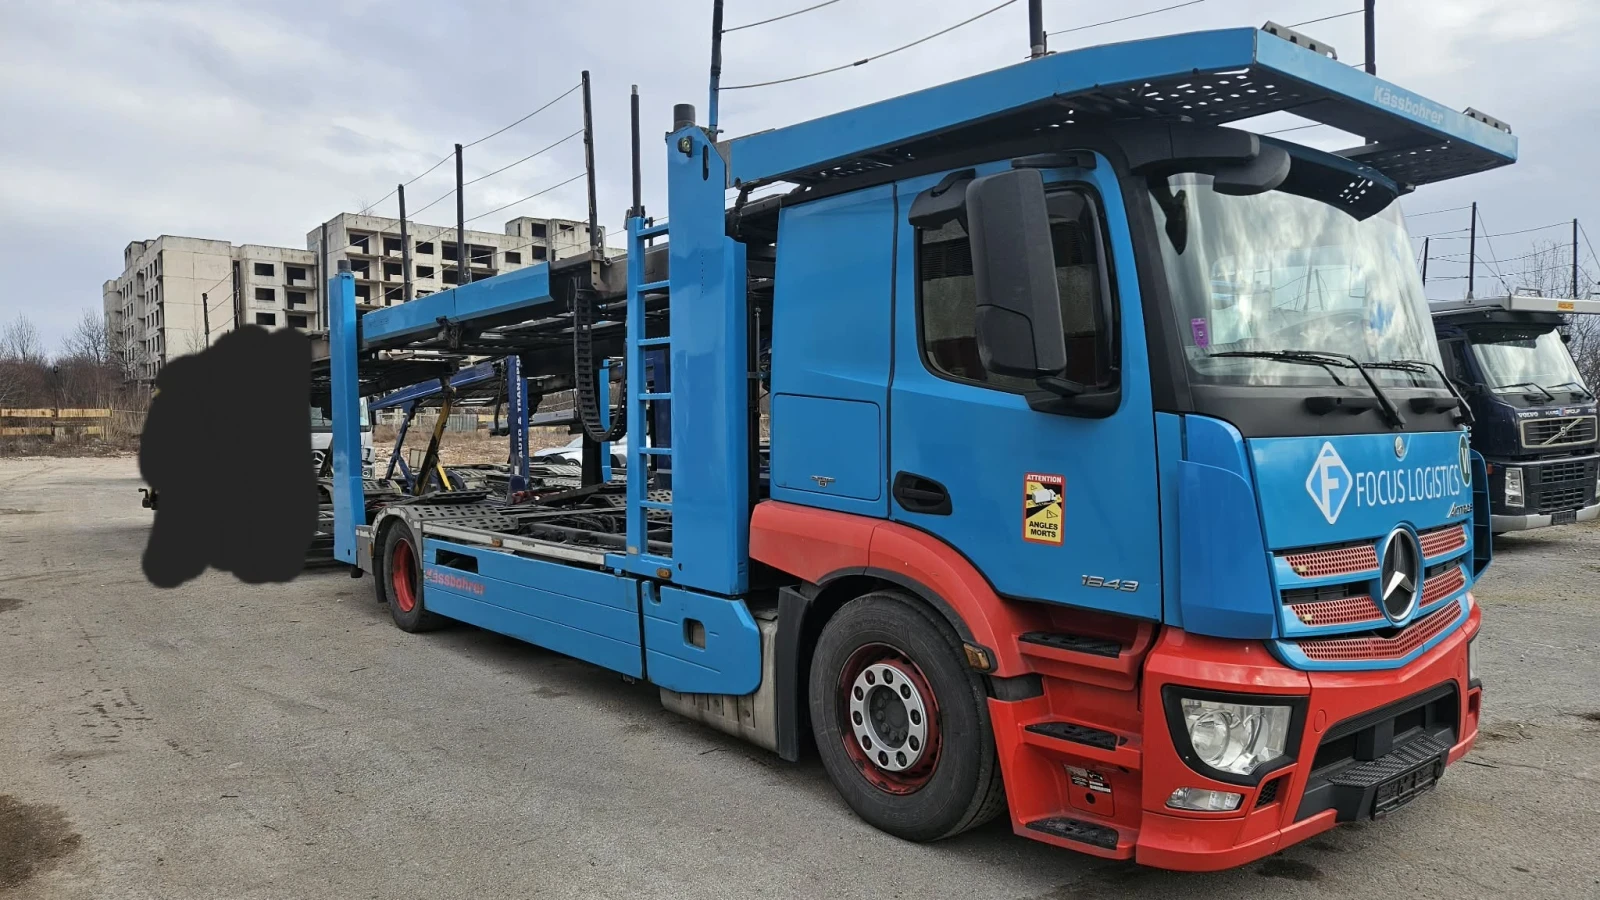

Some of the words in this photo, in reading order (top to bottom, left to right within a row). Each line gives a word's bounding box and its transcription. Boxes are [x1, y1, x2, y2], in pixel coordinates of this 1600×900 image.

[1374, 85, 1444, 124] Kässbohrer
[1027, 474, 1062, 483] ATTENTION
[1356, 468, 1406, 507] FOCUS
[1408, 464, 1460, 502] LOGISTICS
[1029, 521, 1058, 531] ANGLES
[1030, 528, 1056, 538] MORTS
[1081, 574, 1139, 592] 1843
